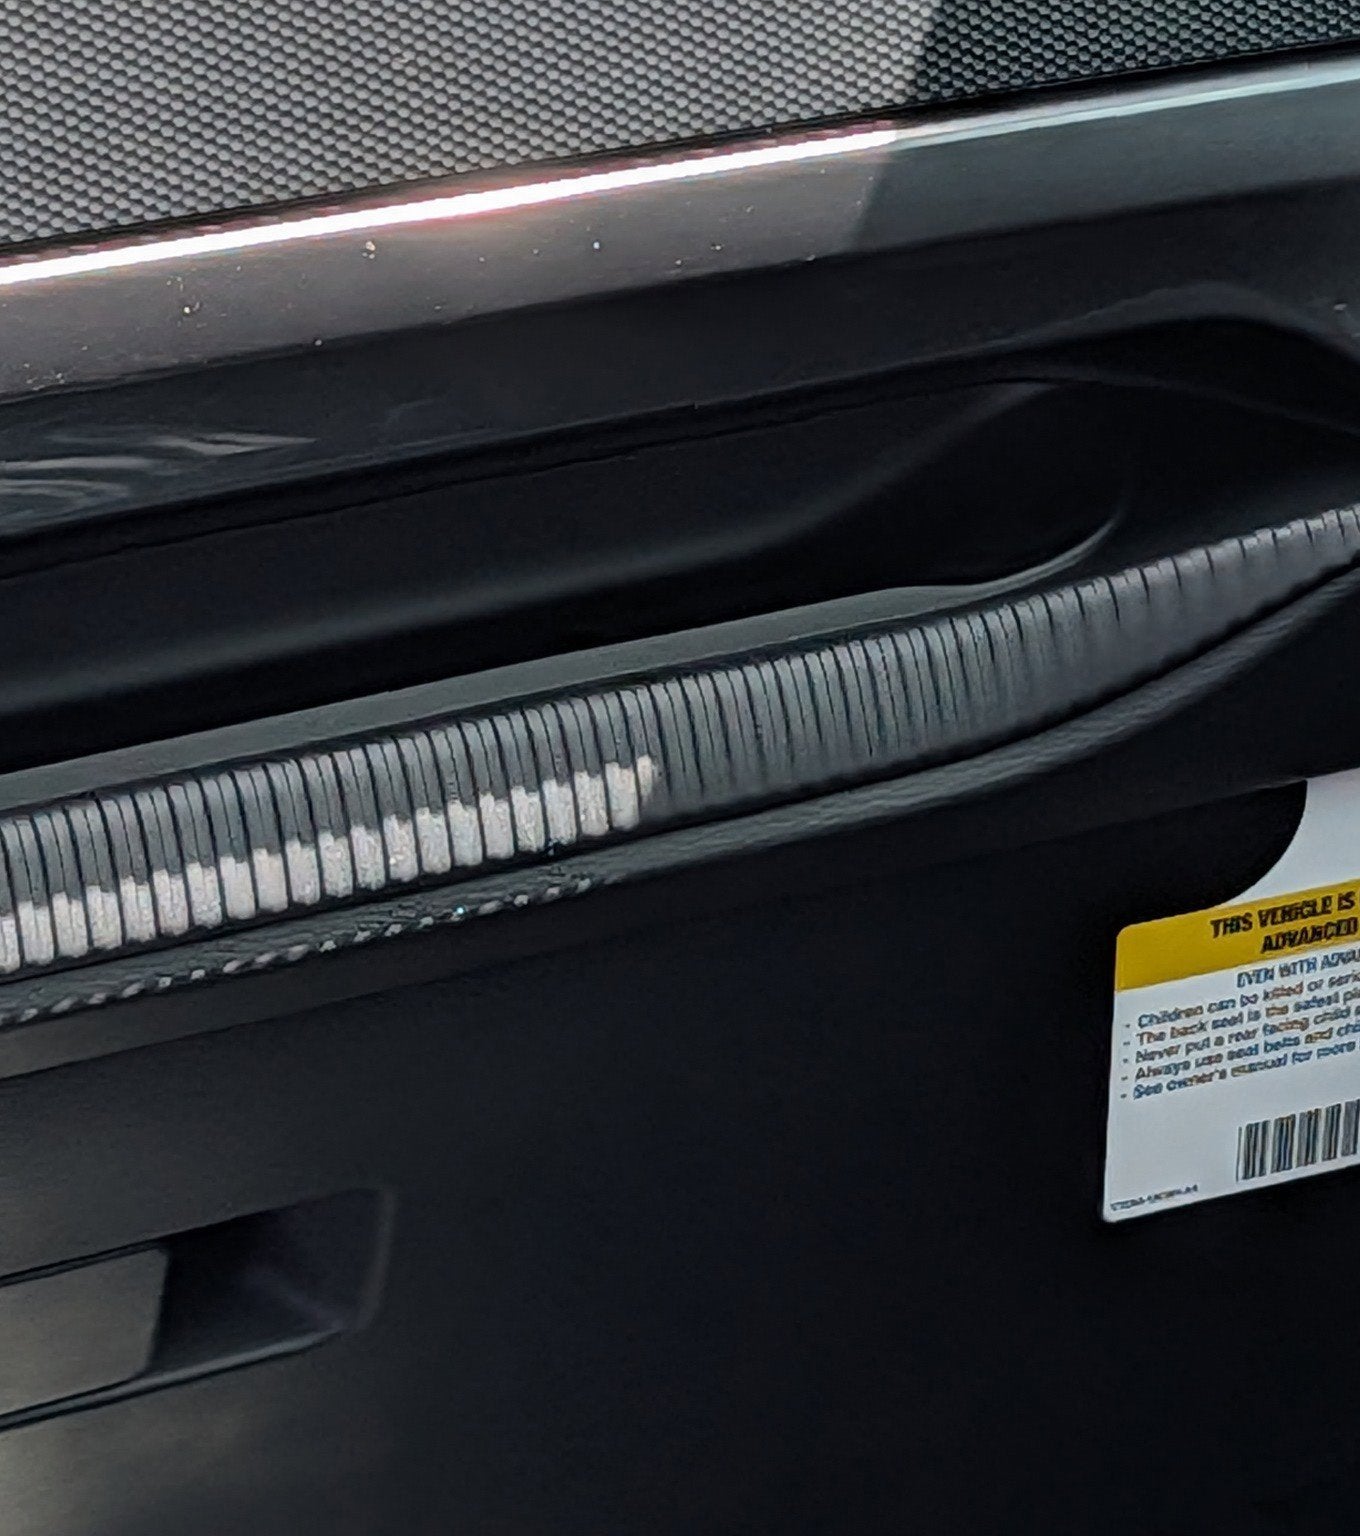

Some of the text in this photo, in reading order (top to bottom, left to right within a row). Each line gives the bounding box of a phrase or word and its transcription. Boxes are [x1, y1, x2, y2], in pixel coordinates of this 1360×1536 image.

[1210, 912, 1252, 938] THIS
[1258, 896, 1332, 928] VEHICLE
[1337, 891, 1355, 912] IS
[1261, 916, 1357, 953] ADVANCED
[1237, 966, 1273, 988] EVEN
[1278, 957, 1317, 979] WITH
